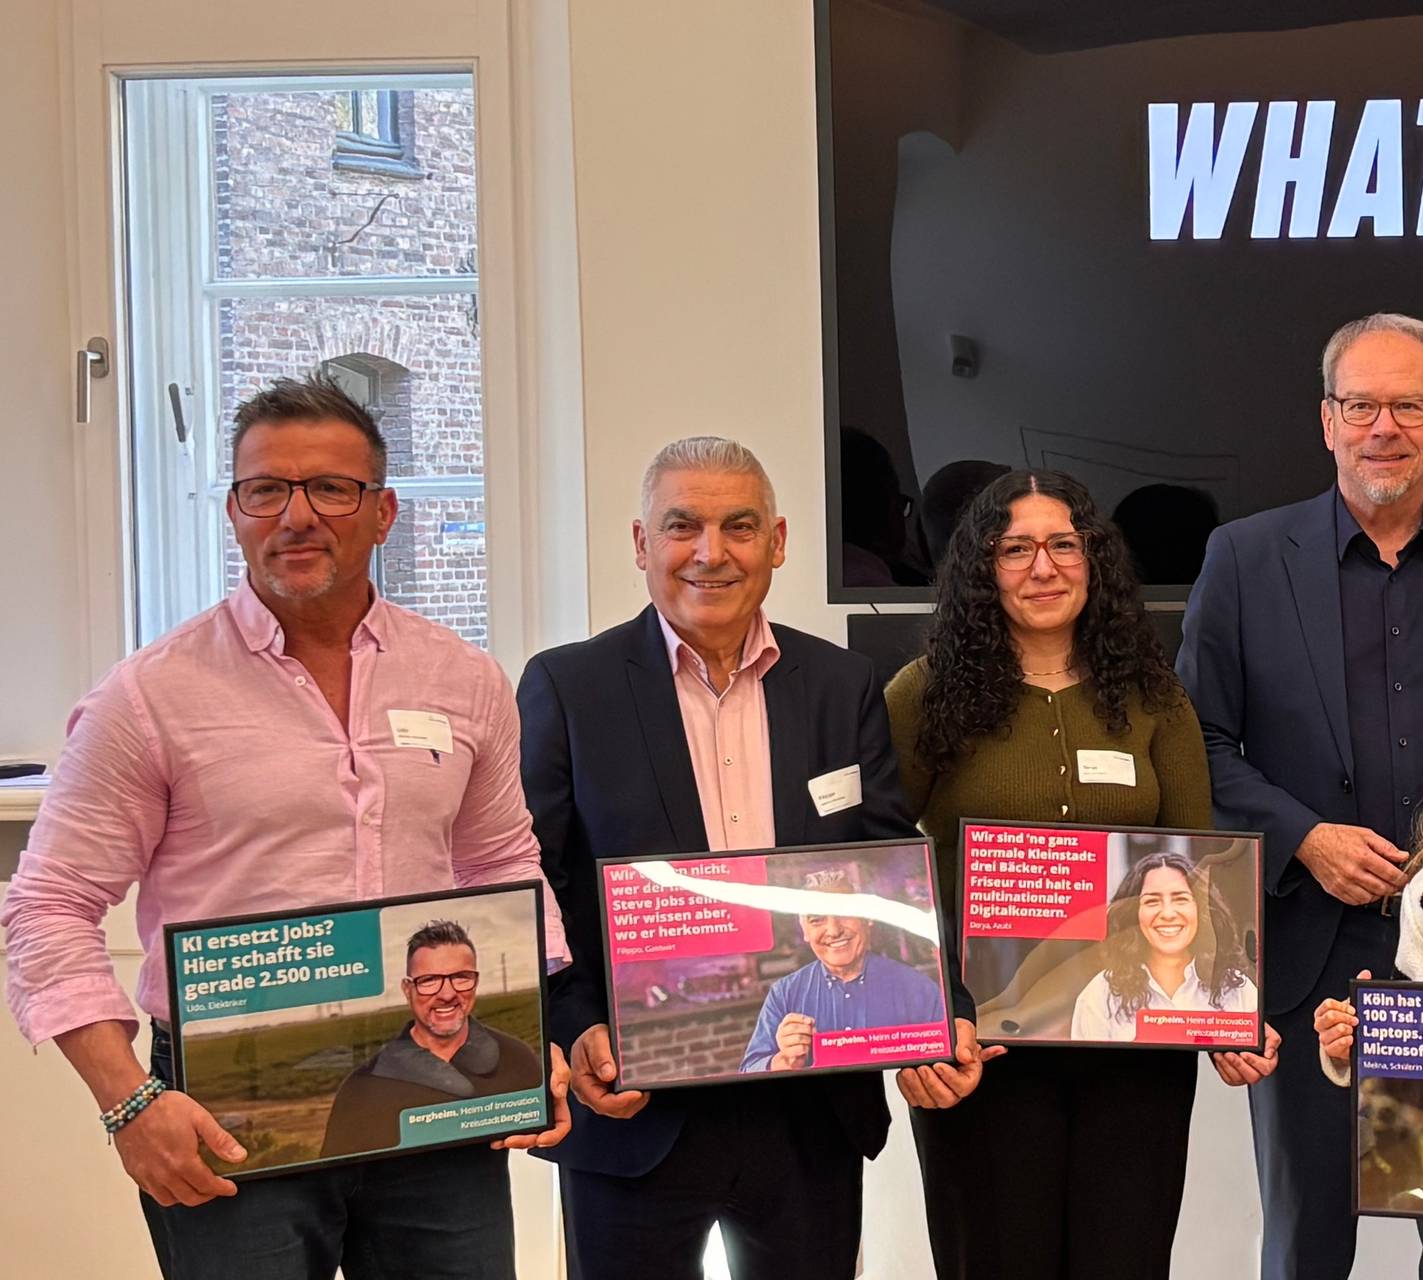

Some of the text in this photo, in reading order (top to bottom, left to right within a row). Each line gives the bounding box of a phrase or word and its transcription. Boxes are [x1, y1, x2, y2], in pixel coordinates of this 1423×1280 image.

[970, 831, 994, 842] Wir
[996, 831, 1024, 844] sind
[1048, 836, 1078, 848] ganz
[970, 848, 1096, 862] normale Kleinstadt:
[610, 868, 636, 882] Wir
[691, 863, 730, 876] nicht,
[970, 861, 1070, 876] drei Bäcker, ein
[612, 885, 639, 896] wer
[970, 876, 1094, 891] Friseur und halt ein
[612, 899, 652, 912] Steve
[656, 896, 685, 911] Jobs
[970, 892, 1072, 904] multinationaler
[614, 908, 730, 926] Wir wissen aber,
[970, 904, 1067, 918] Digitalkonzern.
[182, 920, 334, 953] KI ersetzt Jobs?
[616, 922, 738, 942] wo er herkommt.
[184, 942, 335, 975] Hier schafft sie
[184, 962, 370, 1001] gerade 2.500 neue.
[1363, 993, 1394, 1006] Köln
[1398, 994, 1421, 1008] hat
[1363, 1010, 1387, 1022] 100
[1390, 1010, 1418, 1024] Tsd.
[1363, 1026, 1422, 1042] Laptops.
[408, 1109, 459, 1124] Bergheim.
